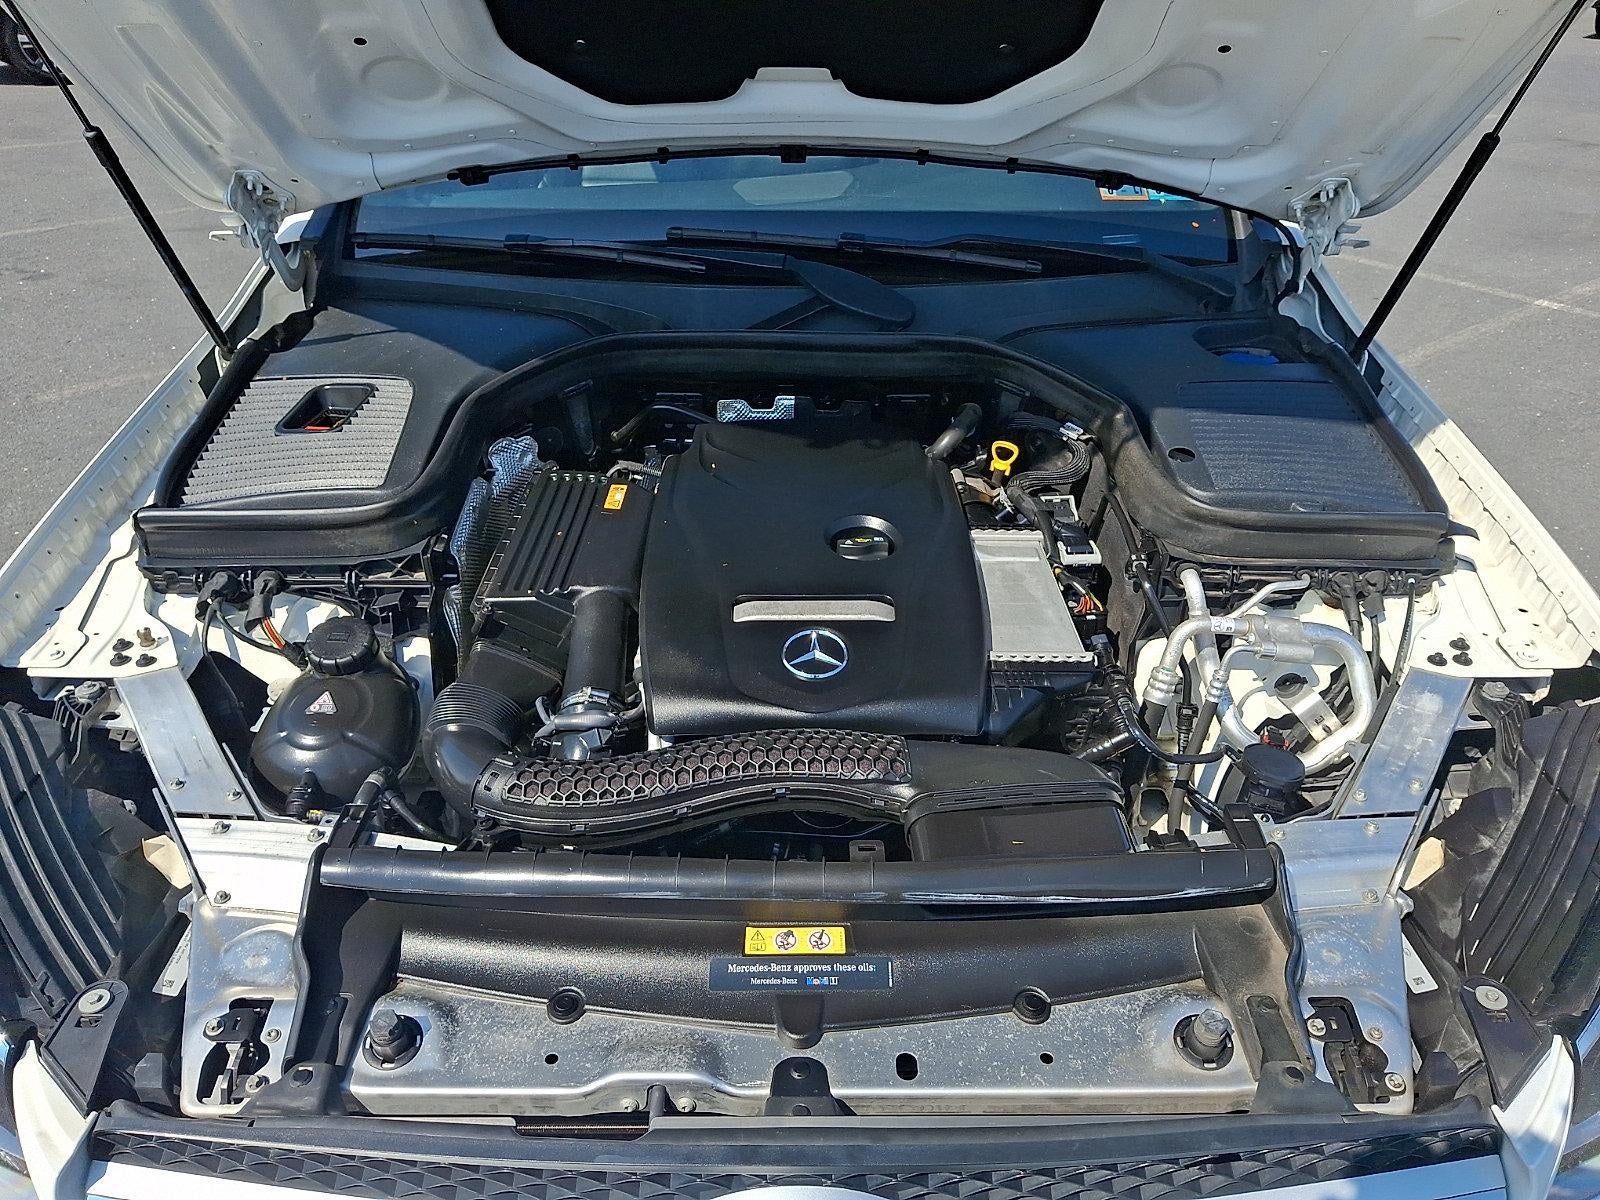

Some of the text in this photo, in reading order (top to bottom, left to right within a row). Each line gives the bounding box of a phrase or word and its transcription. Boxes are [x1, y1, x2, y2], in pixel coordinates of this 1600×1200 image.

[728, 963, 876, 973] Mercedes-Benz approves these oils:
[750, 977, 798, 985] Mercedes-Benz
